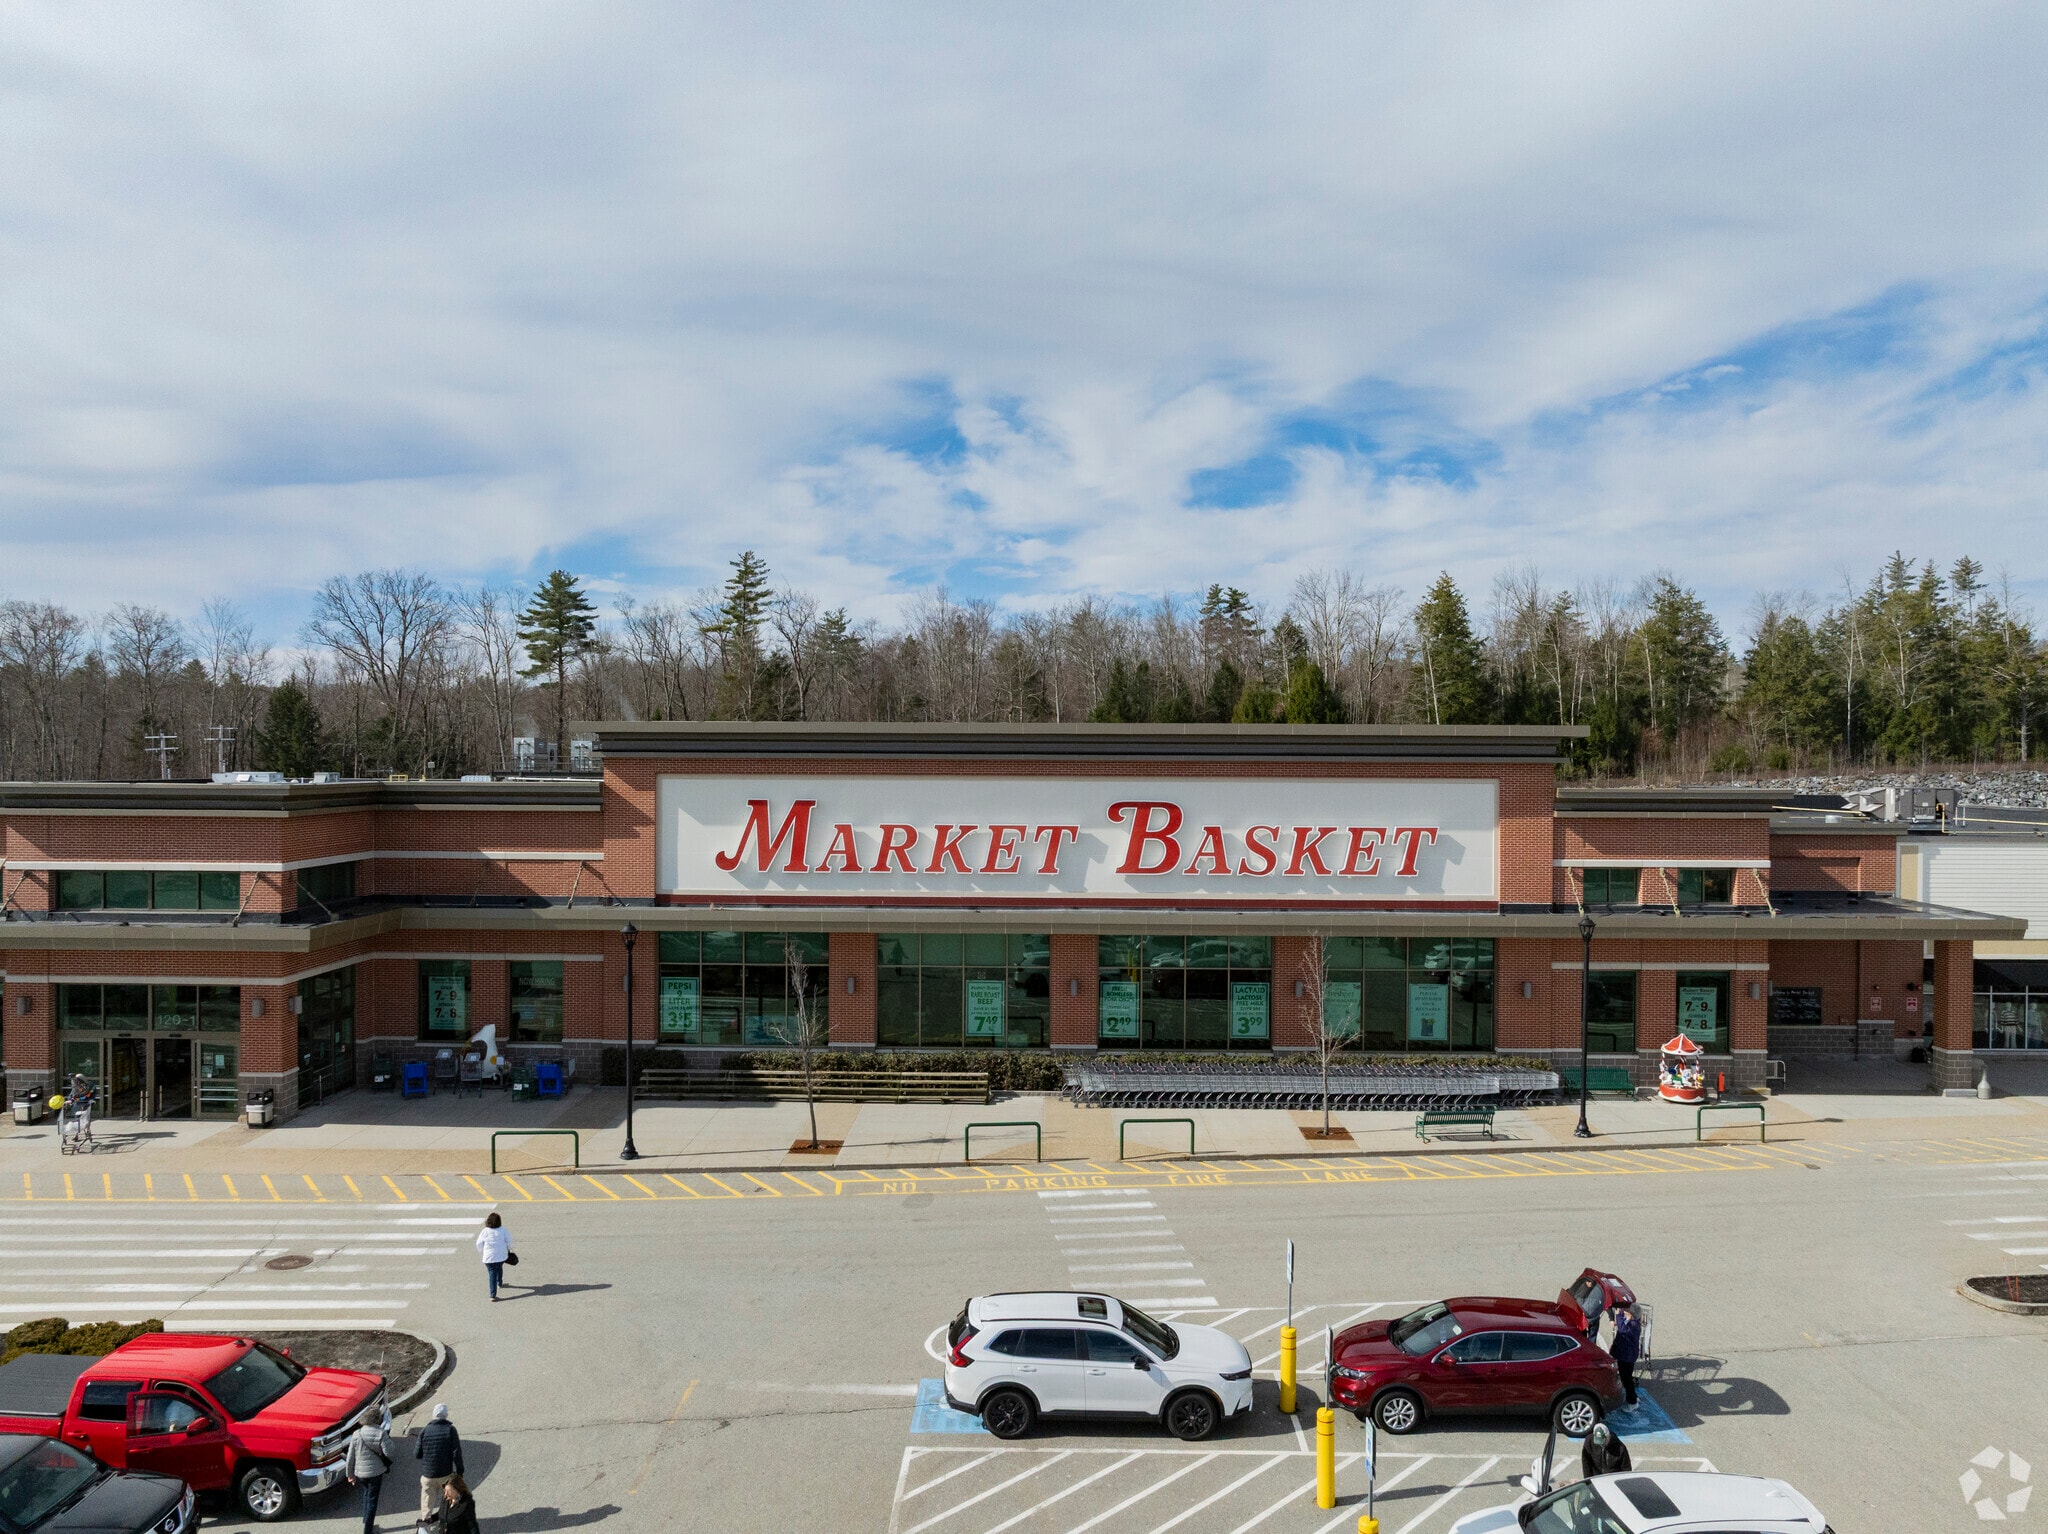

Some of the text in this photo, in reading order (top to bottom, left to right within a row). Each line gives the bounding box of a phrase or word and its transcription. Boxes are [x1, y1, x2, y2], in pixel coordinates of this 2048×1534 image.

[715, 799, 1439, 876] MARKET BASKET
[668, 982, 692, 990] PEPSI
[1235, 986, 1266, 994] LACTAID
[669, 997, 691, 1005] LITER
[882, 1170, 1380, 1193] NO PARKING FIRE LANE
